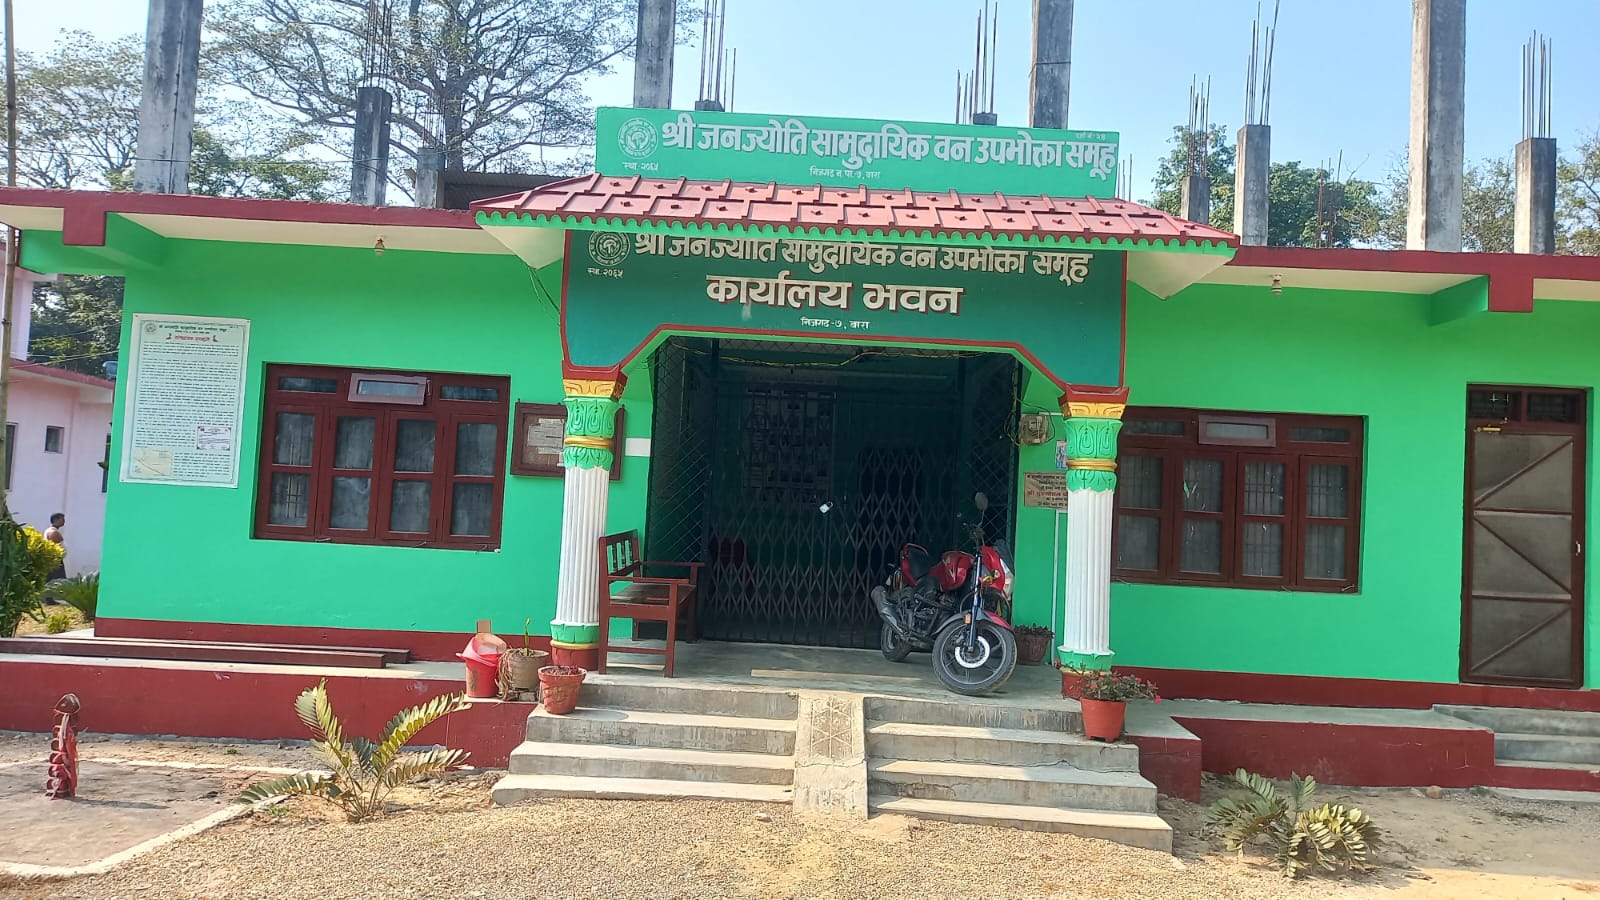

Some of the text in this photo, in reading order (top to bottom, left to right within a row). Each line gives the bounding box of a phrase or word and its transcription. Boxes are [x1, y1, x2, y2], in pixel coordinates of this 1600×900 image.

[662, 112, 697, 149] श्री
[698, 116, 810, 155] जनज्योति
[811, 123, 932, 170] सामुदायिक
[933, 135, 975, 163] वन
[974, 130, 1066, 168] उपभोक्ता
[1066, 141, 1119, 181] समूह
[900, 245, 939, 269] वन
[1032, 251, 1094, 287] समूह
[706, 270, 965, 314] कार्यालय भवन
